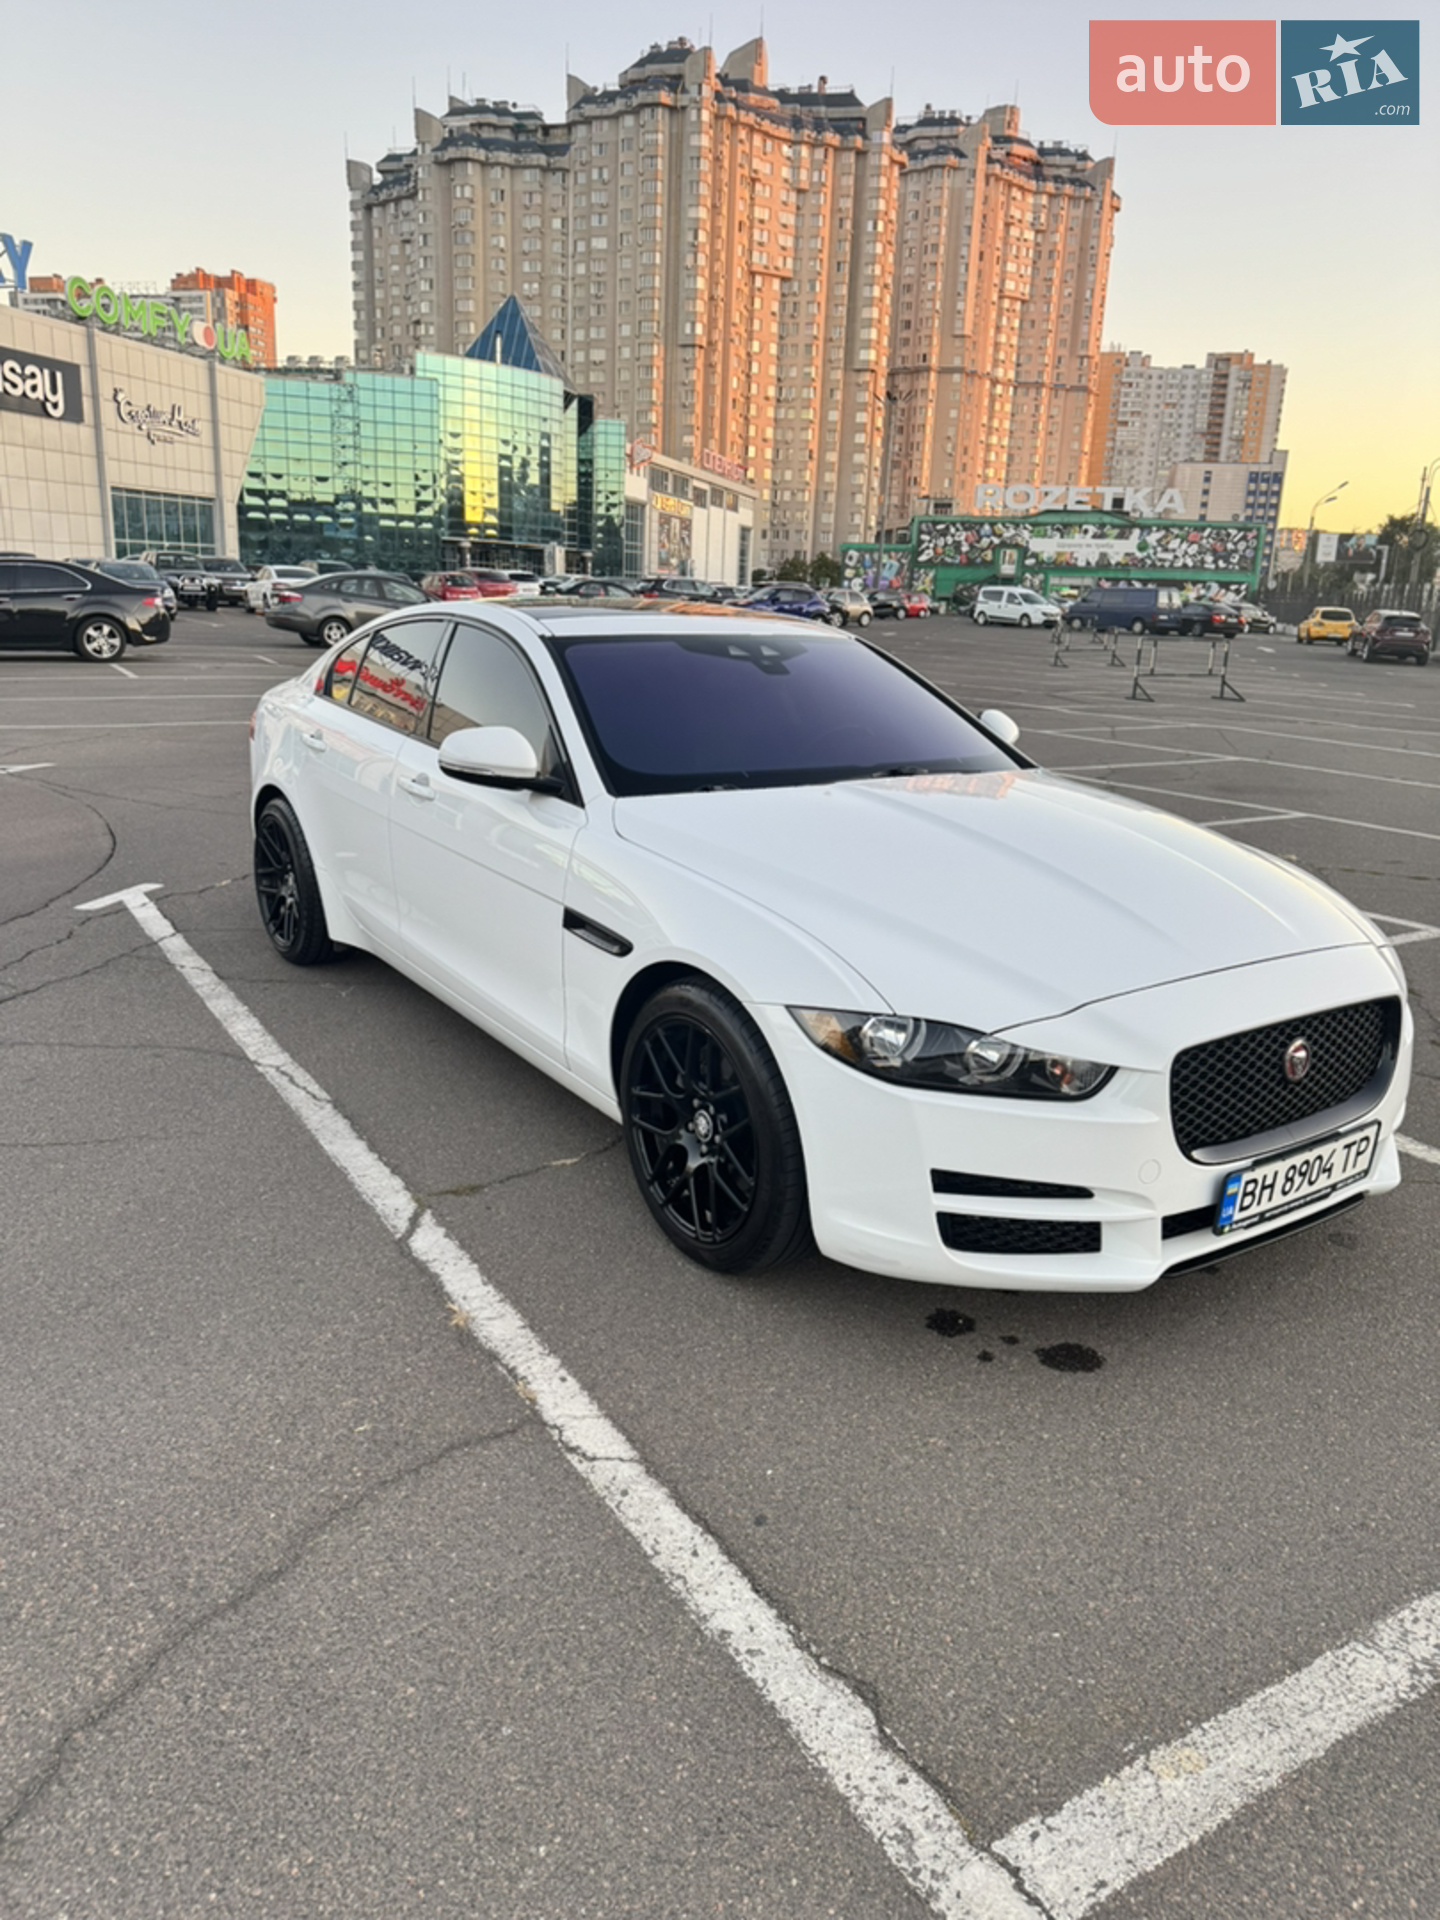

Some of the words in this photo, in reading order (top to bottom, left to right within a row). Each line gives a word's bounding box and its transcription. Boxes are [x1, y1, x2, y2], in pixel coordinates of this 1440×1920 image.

[65, 275, 192, 345] COMFY
[0, 359, 65, 418] say
[975, 484, 1185, 513] ROZETKA
[1238, 1169, 1279, 1213] BH
[1281, 1148, 1337, 1197] 8904
[1342, 1135, 1371, 1174] TP
